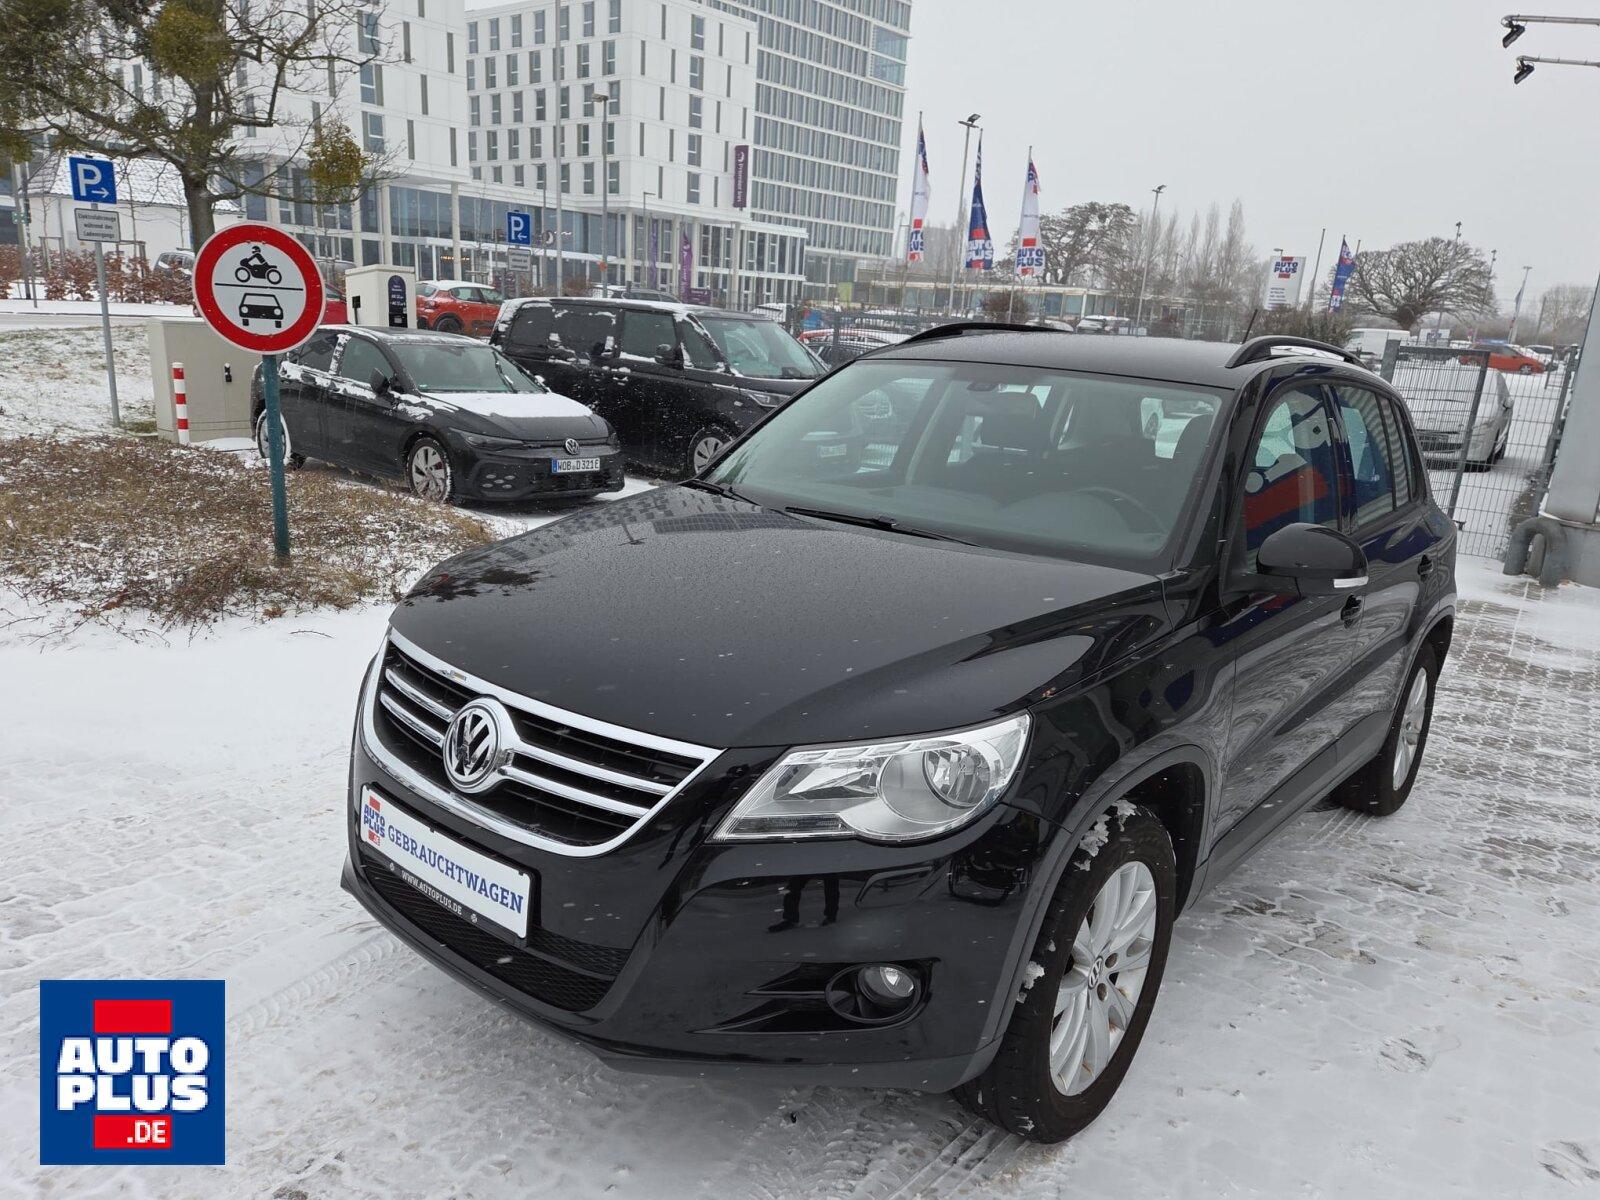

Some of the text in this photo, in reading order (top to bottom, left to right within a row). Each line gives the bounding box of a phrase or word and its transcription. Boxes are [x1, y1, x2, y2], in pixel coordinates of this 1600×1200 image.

[77, 163, 102, 197] P
[511, 216, 524, 240] P
[1016, 257, 1043, 267] PLUS
[1017, 248, 1044, 258] AUTO
[558, 461, 571, 470] WOB
[363, 804, 385, 827] AUTO
[363, 814, 385, 838] PLUS
[388, 824, 524, 914] GEBRAUCHTWAGEN
[401, 871, 462, 916] WWW.AUTOPLUS.DE
